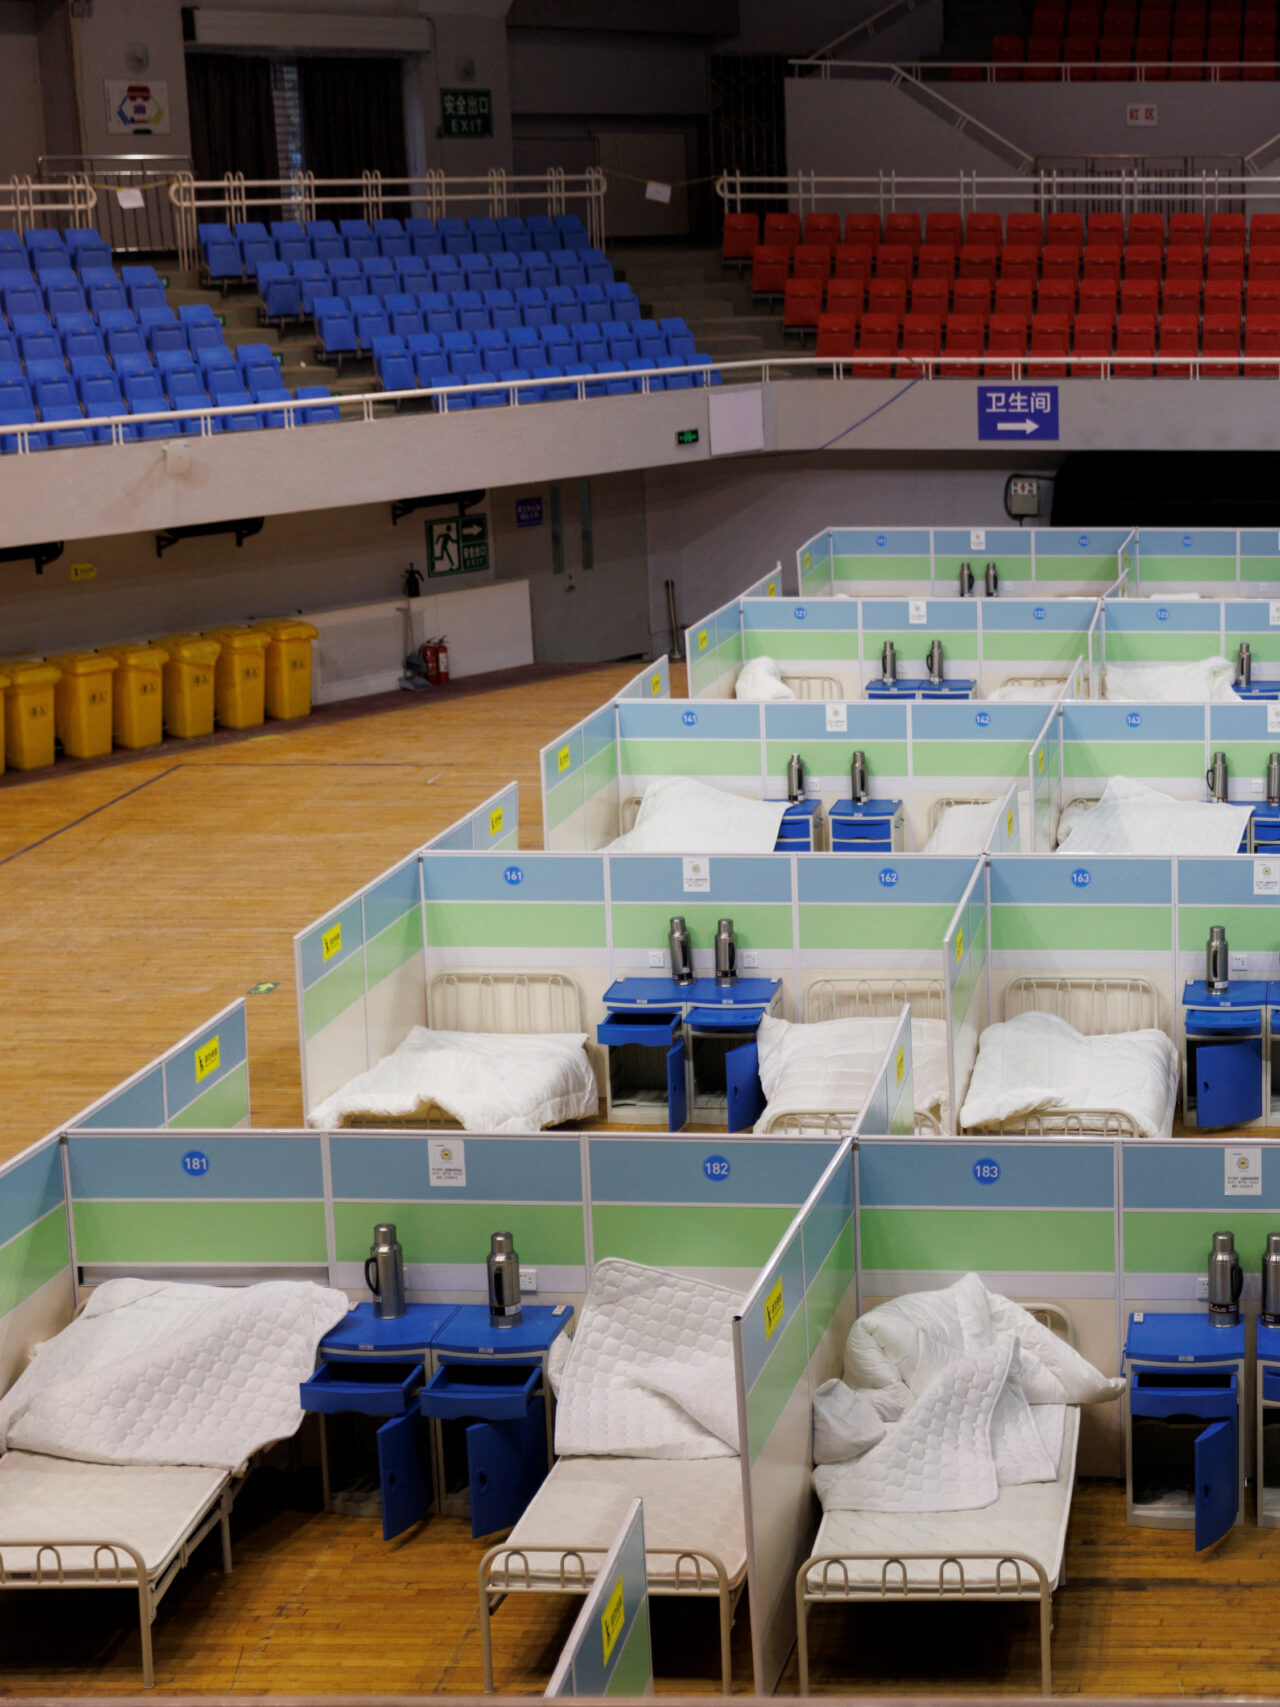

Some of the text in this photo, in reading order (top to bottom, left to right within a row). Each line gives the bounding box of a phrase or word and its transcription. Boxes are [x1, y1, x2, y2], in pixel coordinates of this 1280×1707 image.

[443, 89, 489, 116] 安全出口
[451, 119, 482, 133] EXIT
[985, 391, 1051, 414] 卫生间
[683, 715, 697, 723] 141
[976, 715, 990, 724] 142
[1127, 716, 1141, 724] 143
[505, 871, 522, 881] 161
[880, 873, 897, 883] 162
[1072, 873, 1089, 883] 163
[185, 1158, 207, 1170] 181
[705, 1162, 729, 1175] 182
[975, 1165, 998, 1178] 183
